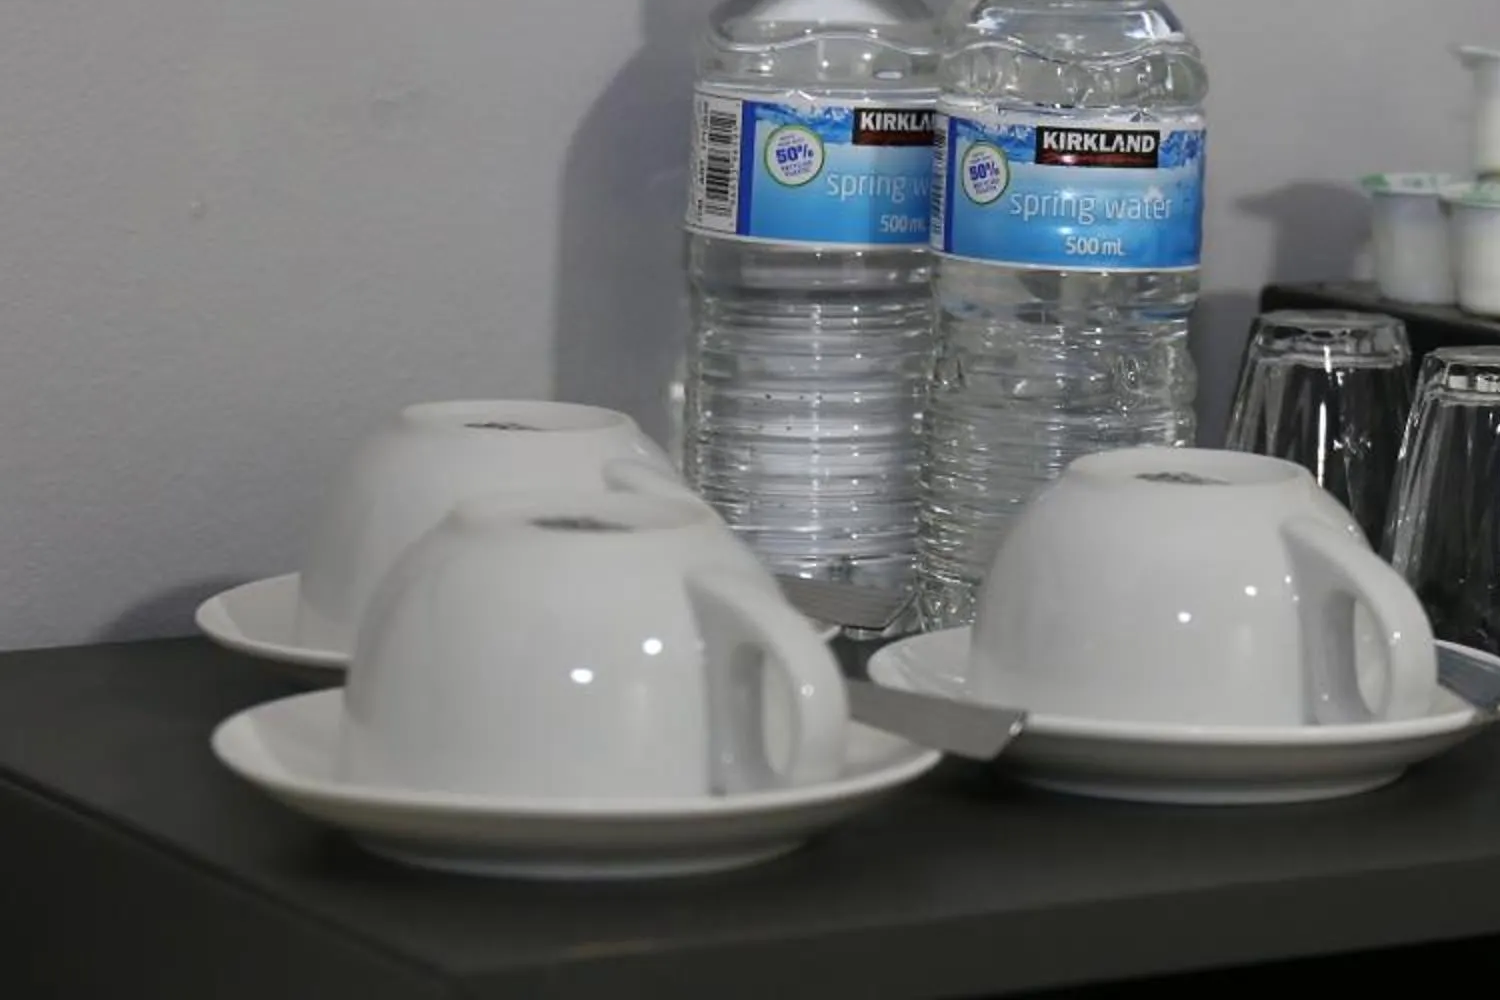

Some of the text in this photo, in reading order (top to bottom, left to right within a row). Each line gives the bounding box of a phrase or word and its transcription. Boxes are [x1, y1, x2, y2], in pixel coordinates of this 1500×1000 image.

[861, 111, 935, 132] KIRKLA
[1042, 131, 1156, 154] KIRKLAND
[775, 143, 815, 165] 50%
[969, 161, 1000, 181] 50%
[826, 172, 907, 203] spring
[1010, 191, 1173, 225] spring water
[879, 214, 908, 233] 500
[1065, 236, 1099, 255] 500
